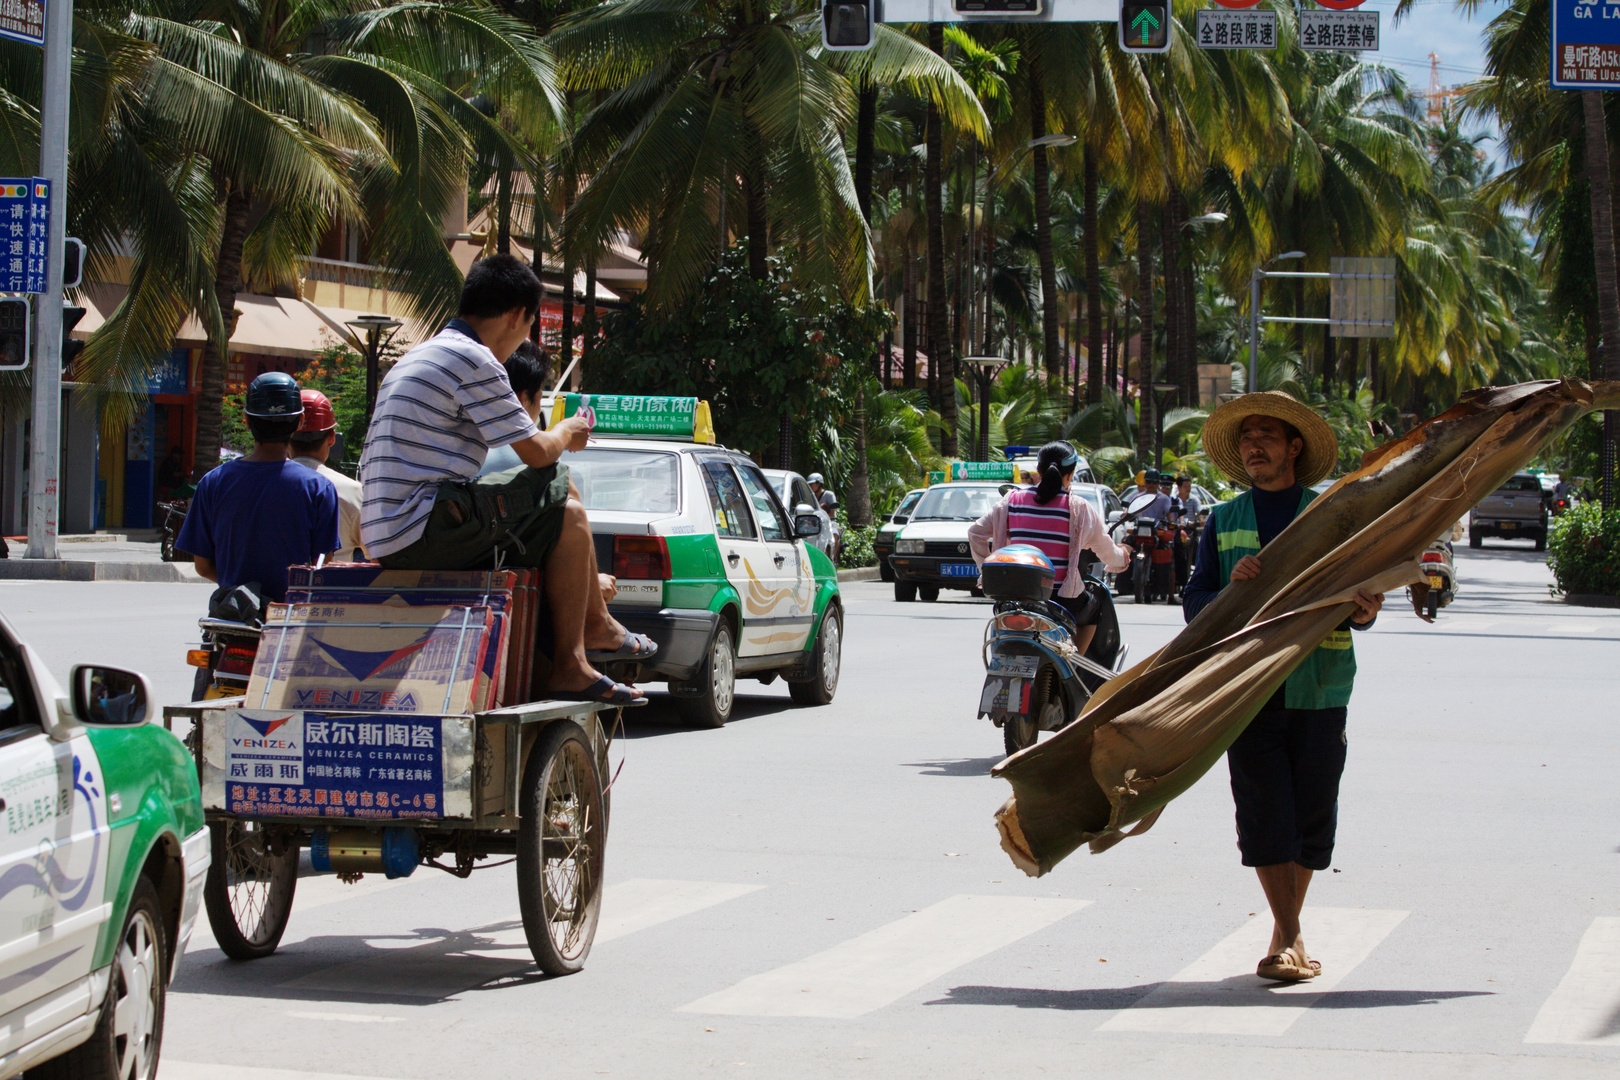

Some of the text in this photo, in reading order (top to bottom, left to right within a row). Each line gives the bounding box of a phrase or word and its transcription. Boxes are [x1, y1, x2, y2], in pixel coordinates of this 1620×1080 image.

[1574, 6, 1592, 19] GA
[1201, 22, 1273, 46] 全路段限速
[1303, 23, 1376, 47] 全路段禁停
[1564, 45, 1620, 68] 曼听路0.5k
[1563, 68, 1577, 80] MAN
[1580, 69, 1597, 80] TING
[1600, 69, 1609, 80] LU
[9, 204, 24, 291] 请快速通行
[596, 396, 692, 413] 皇朝傢俬
[296, 690, 417, 705] VENIZEA
[306, 722, 434, 748] 威尔斯陶瓷
[233, 738, 297, 749] VENIZEA
[308, 749, 434, 761] VENIZEA CERAMICS
[307, 765, 432, 781] 中国驰名商标 广东省著名商标
